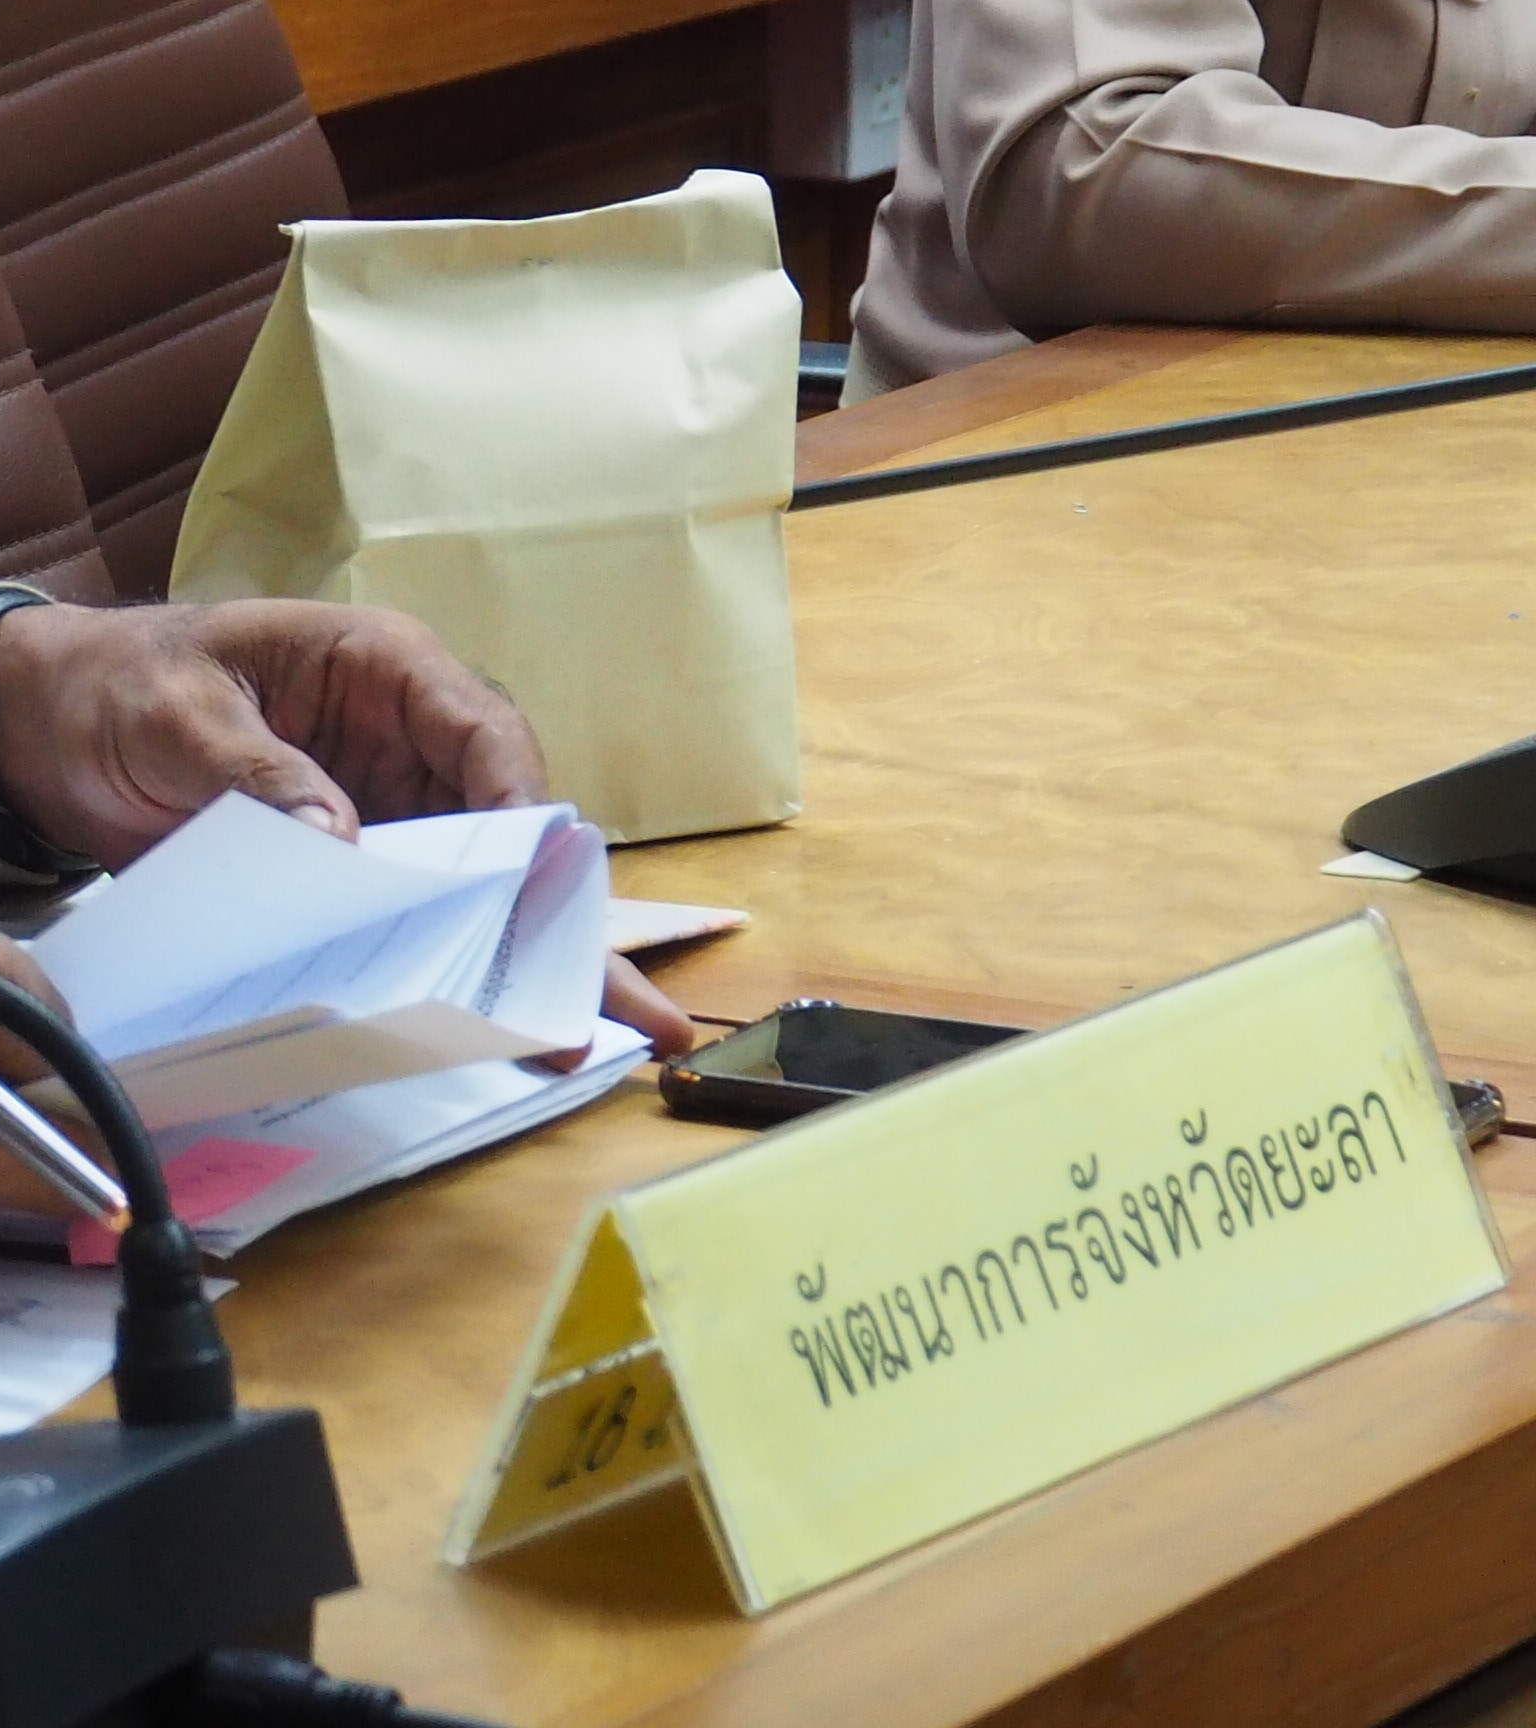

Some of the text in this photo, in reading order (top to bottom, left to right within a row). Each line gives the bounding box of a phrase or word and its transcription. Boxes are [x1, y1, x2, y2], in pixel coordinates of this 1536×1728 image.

[786, 1088, 1408, 1410] พัฒนาการจังหวัดยะลา
